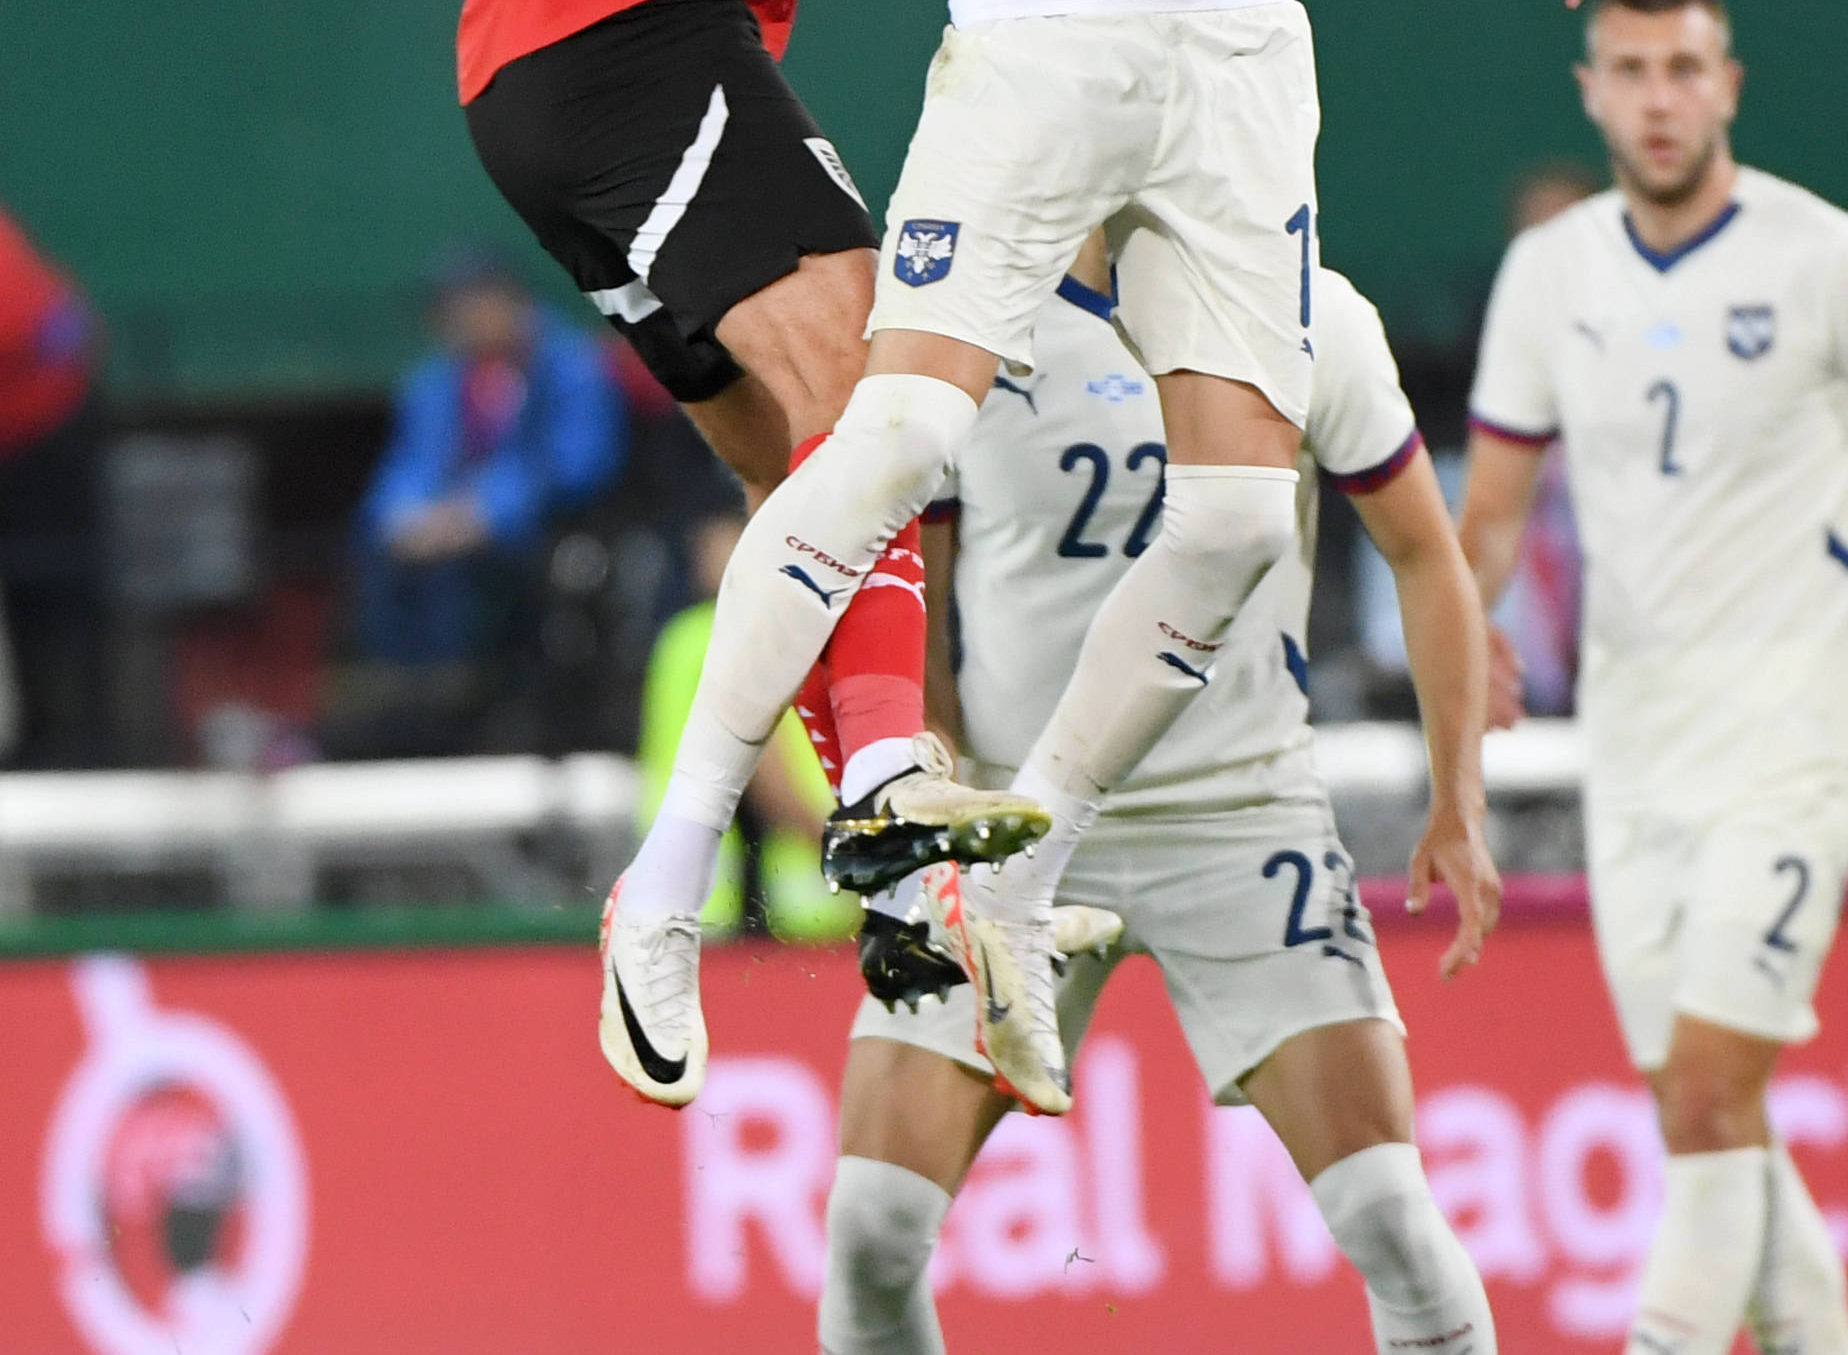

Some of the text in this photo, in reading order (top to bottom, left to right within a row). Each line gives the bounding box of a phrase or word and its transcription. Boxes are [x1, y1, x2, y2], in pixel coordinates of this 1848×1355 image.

[1645, 380, 1686, 477] 2
[1057, 442, 1168, 558] 22
[1762, 855, 1810, 954] 2
[685, 1035, 1166, 1303] Ral
